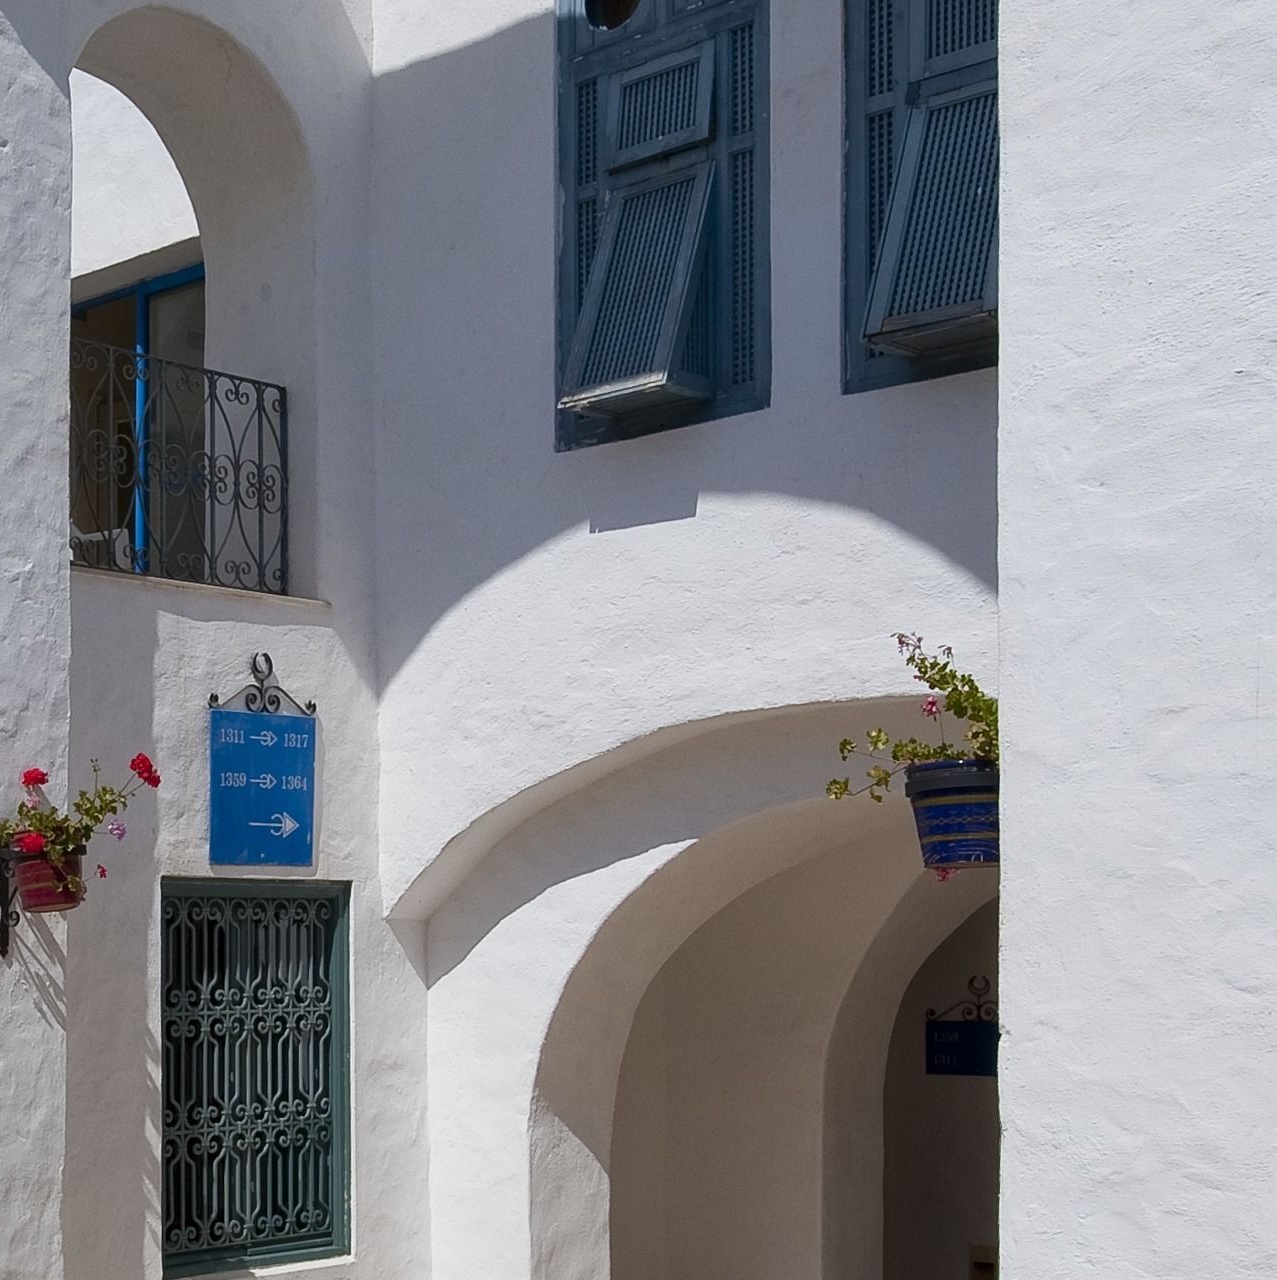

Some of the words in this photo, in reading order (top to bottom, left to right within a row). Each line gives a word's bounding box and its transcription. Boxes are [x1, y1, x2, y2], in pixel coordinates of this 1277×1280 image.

[220, 728, 245, 744] 1311
[283, 733, 309, 748] 1317
[220, 772, 247, 787] 1359
[281, 775, 307, 791] 1364
